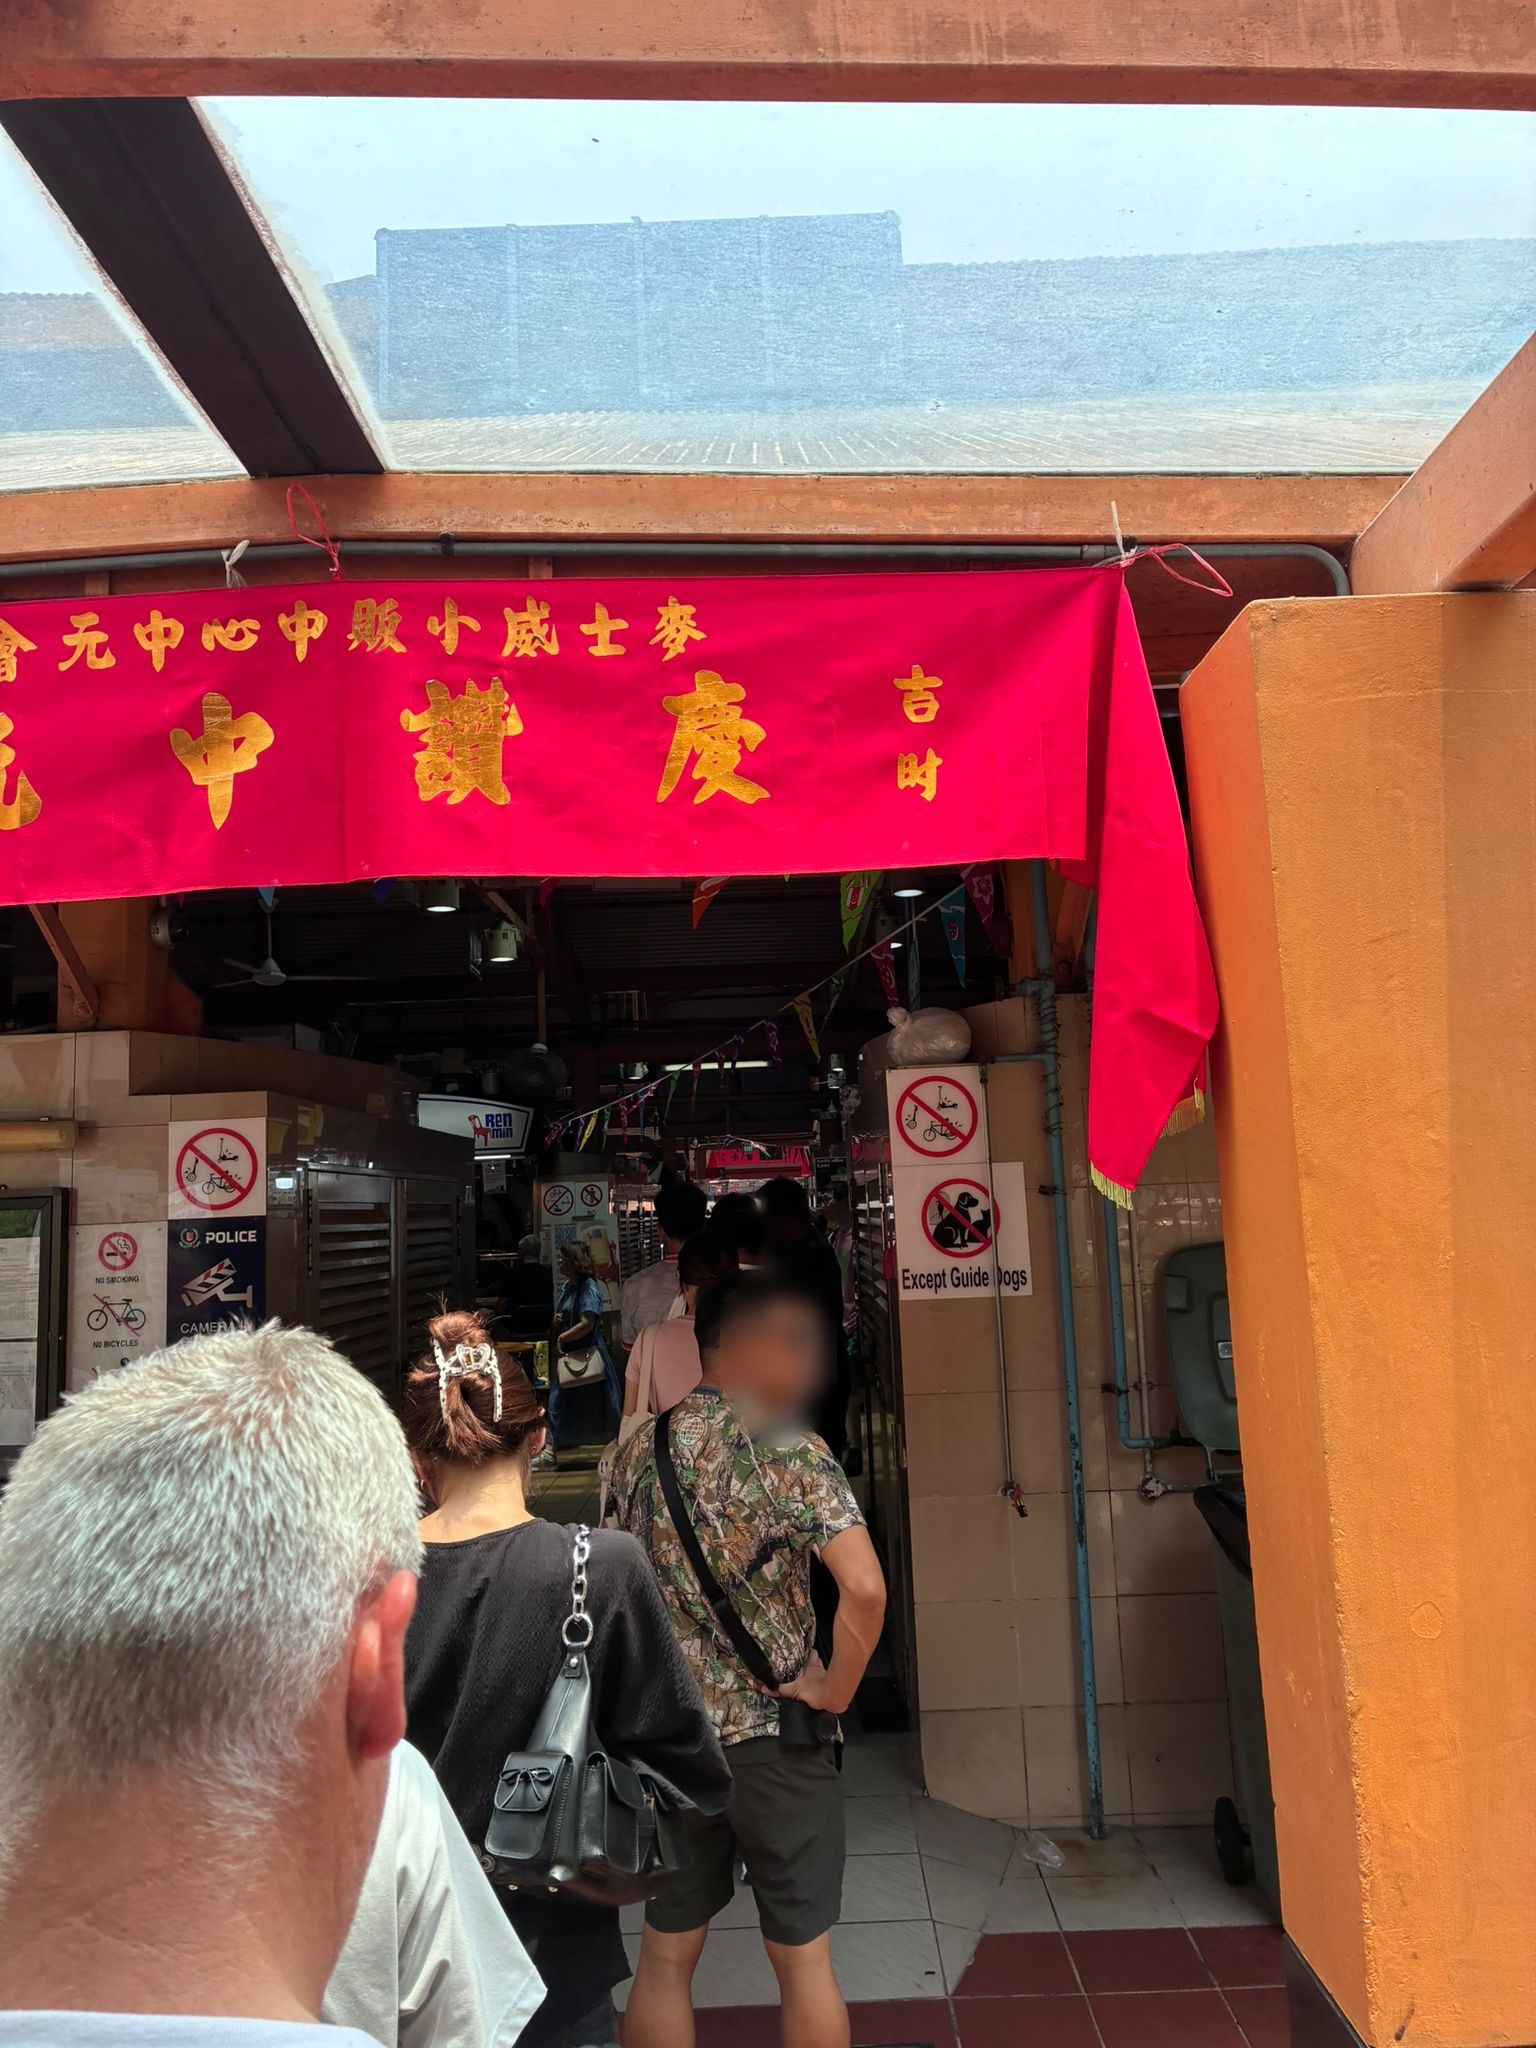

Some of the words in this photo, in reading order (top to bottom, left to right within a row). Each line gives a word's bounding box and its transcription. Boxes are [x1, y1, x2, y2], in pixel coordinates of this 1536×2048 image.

[485, 1113, 512, 1128] Ren
[492, 1127, 513, 1139] min
[205, 1230, 257, 1245] POLICE
[106, 1275, 140, 1284] SMOKING
[902, 1267, 947, 1293] Except
[950, 1266, 990, 1289] Guide
[93, 1341, 102, 1349] NO
[103, 1340, 139, 1348] BICYCLES
